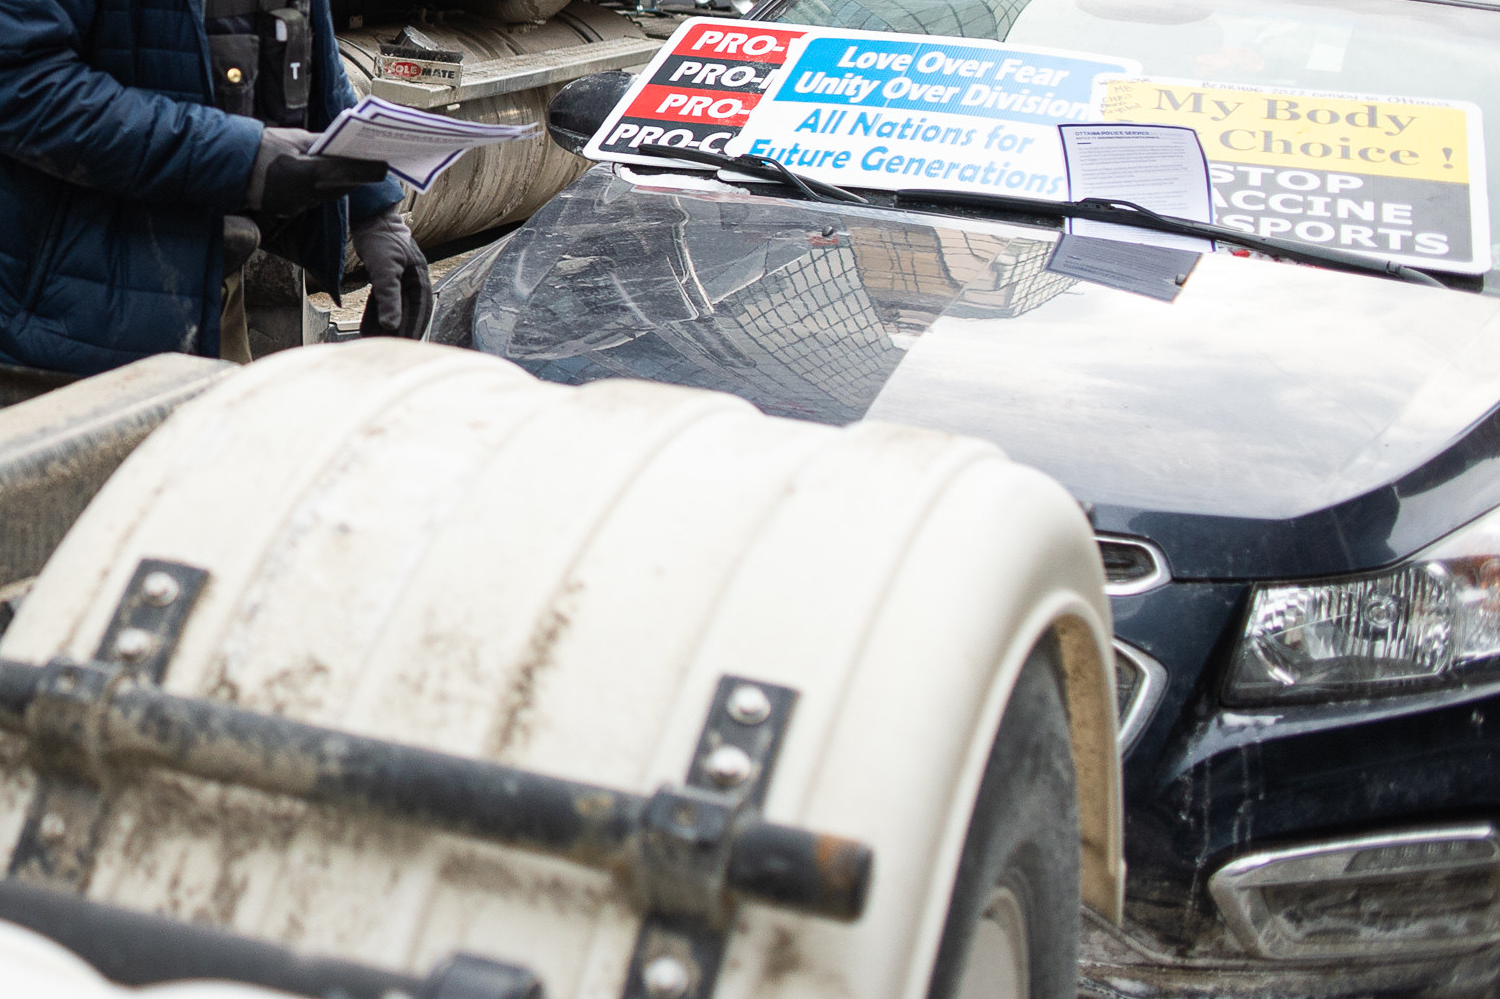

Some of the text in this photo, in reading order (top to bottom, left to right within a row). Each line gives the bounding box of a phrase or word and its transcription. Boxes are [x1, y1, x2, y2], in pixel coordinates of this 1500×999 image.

[421, 67, 455, 79] MATE
[836, 45, 1070, 87] Love Over Fear
[794, 71, 1093, 121] Unity Over Division
[1153, 88, 1419, 136] My Body
[794, 108, 1035, 154] All Nations for
[1219, 128, 1420, 166] Choice
[748, 138, 851, 170] Future
[861, 145, 1066, 195] Generations
[1210, 163, 1364, 195] STOP
[1214, 180, 1413, 226] CCINE
[1214, 213, 1450, 256] SPORTS
